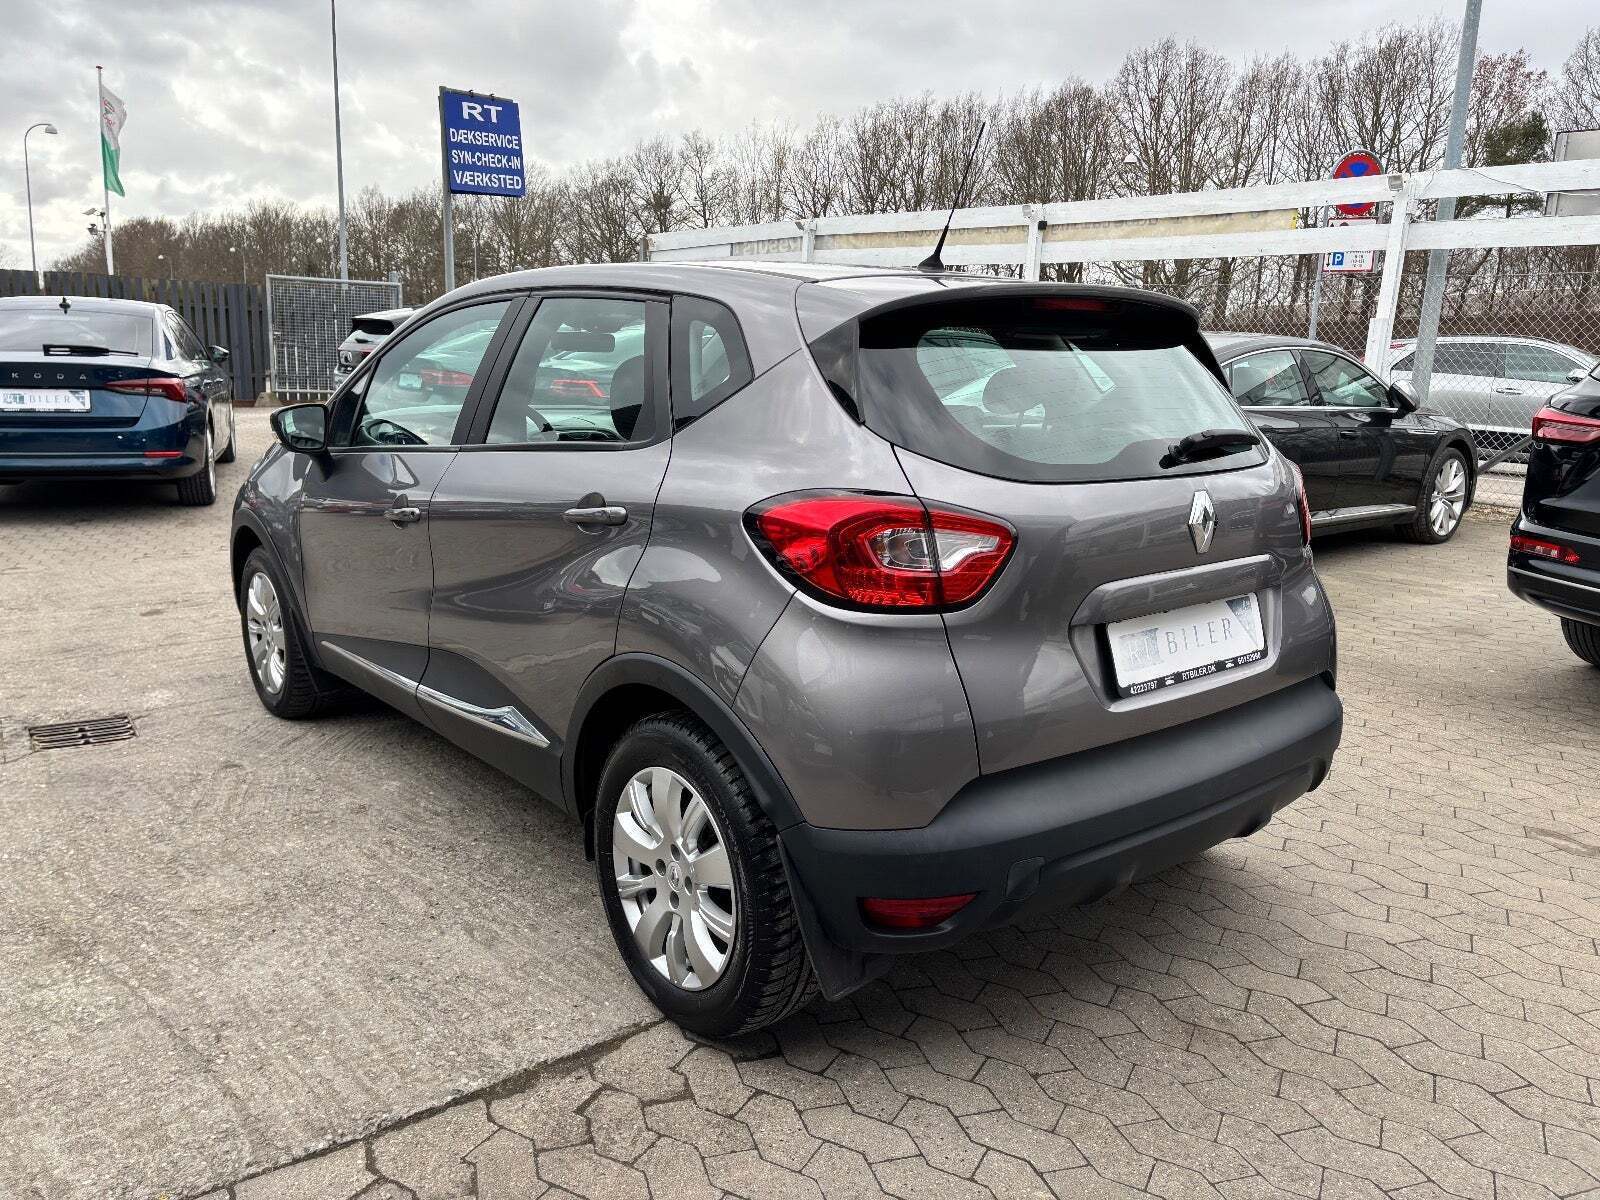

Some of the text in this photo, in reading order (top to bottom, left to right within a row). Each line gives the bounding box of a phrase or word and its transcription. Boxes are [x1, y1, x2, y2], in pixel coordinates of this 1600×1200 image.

[461, 101, 502, 123] RT
[449, 128, 520, 149] DÆKSERVICE
[451, 149, 520, 170] SYN-CHECK-IN
[453, 169, 522, 189] VÆRKSTED
[29, 394, 71, 404] BILER
[1165, 617, 1233, 655] BILER
[1182, 665, 1217, 681] RTBILER.DK
